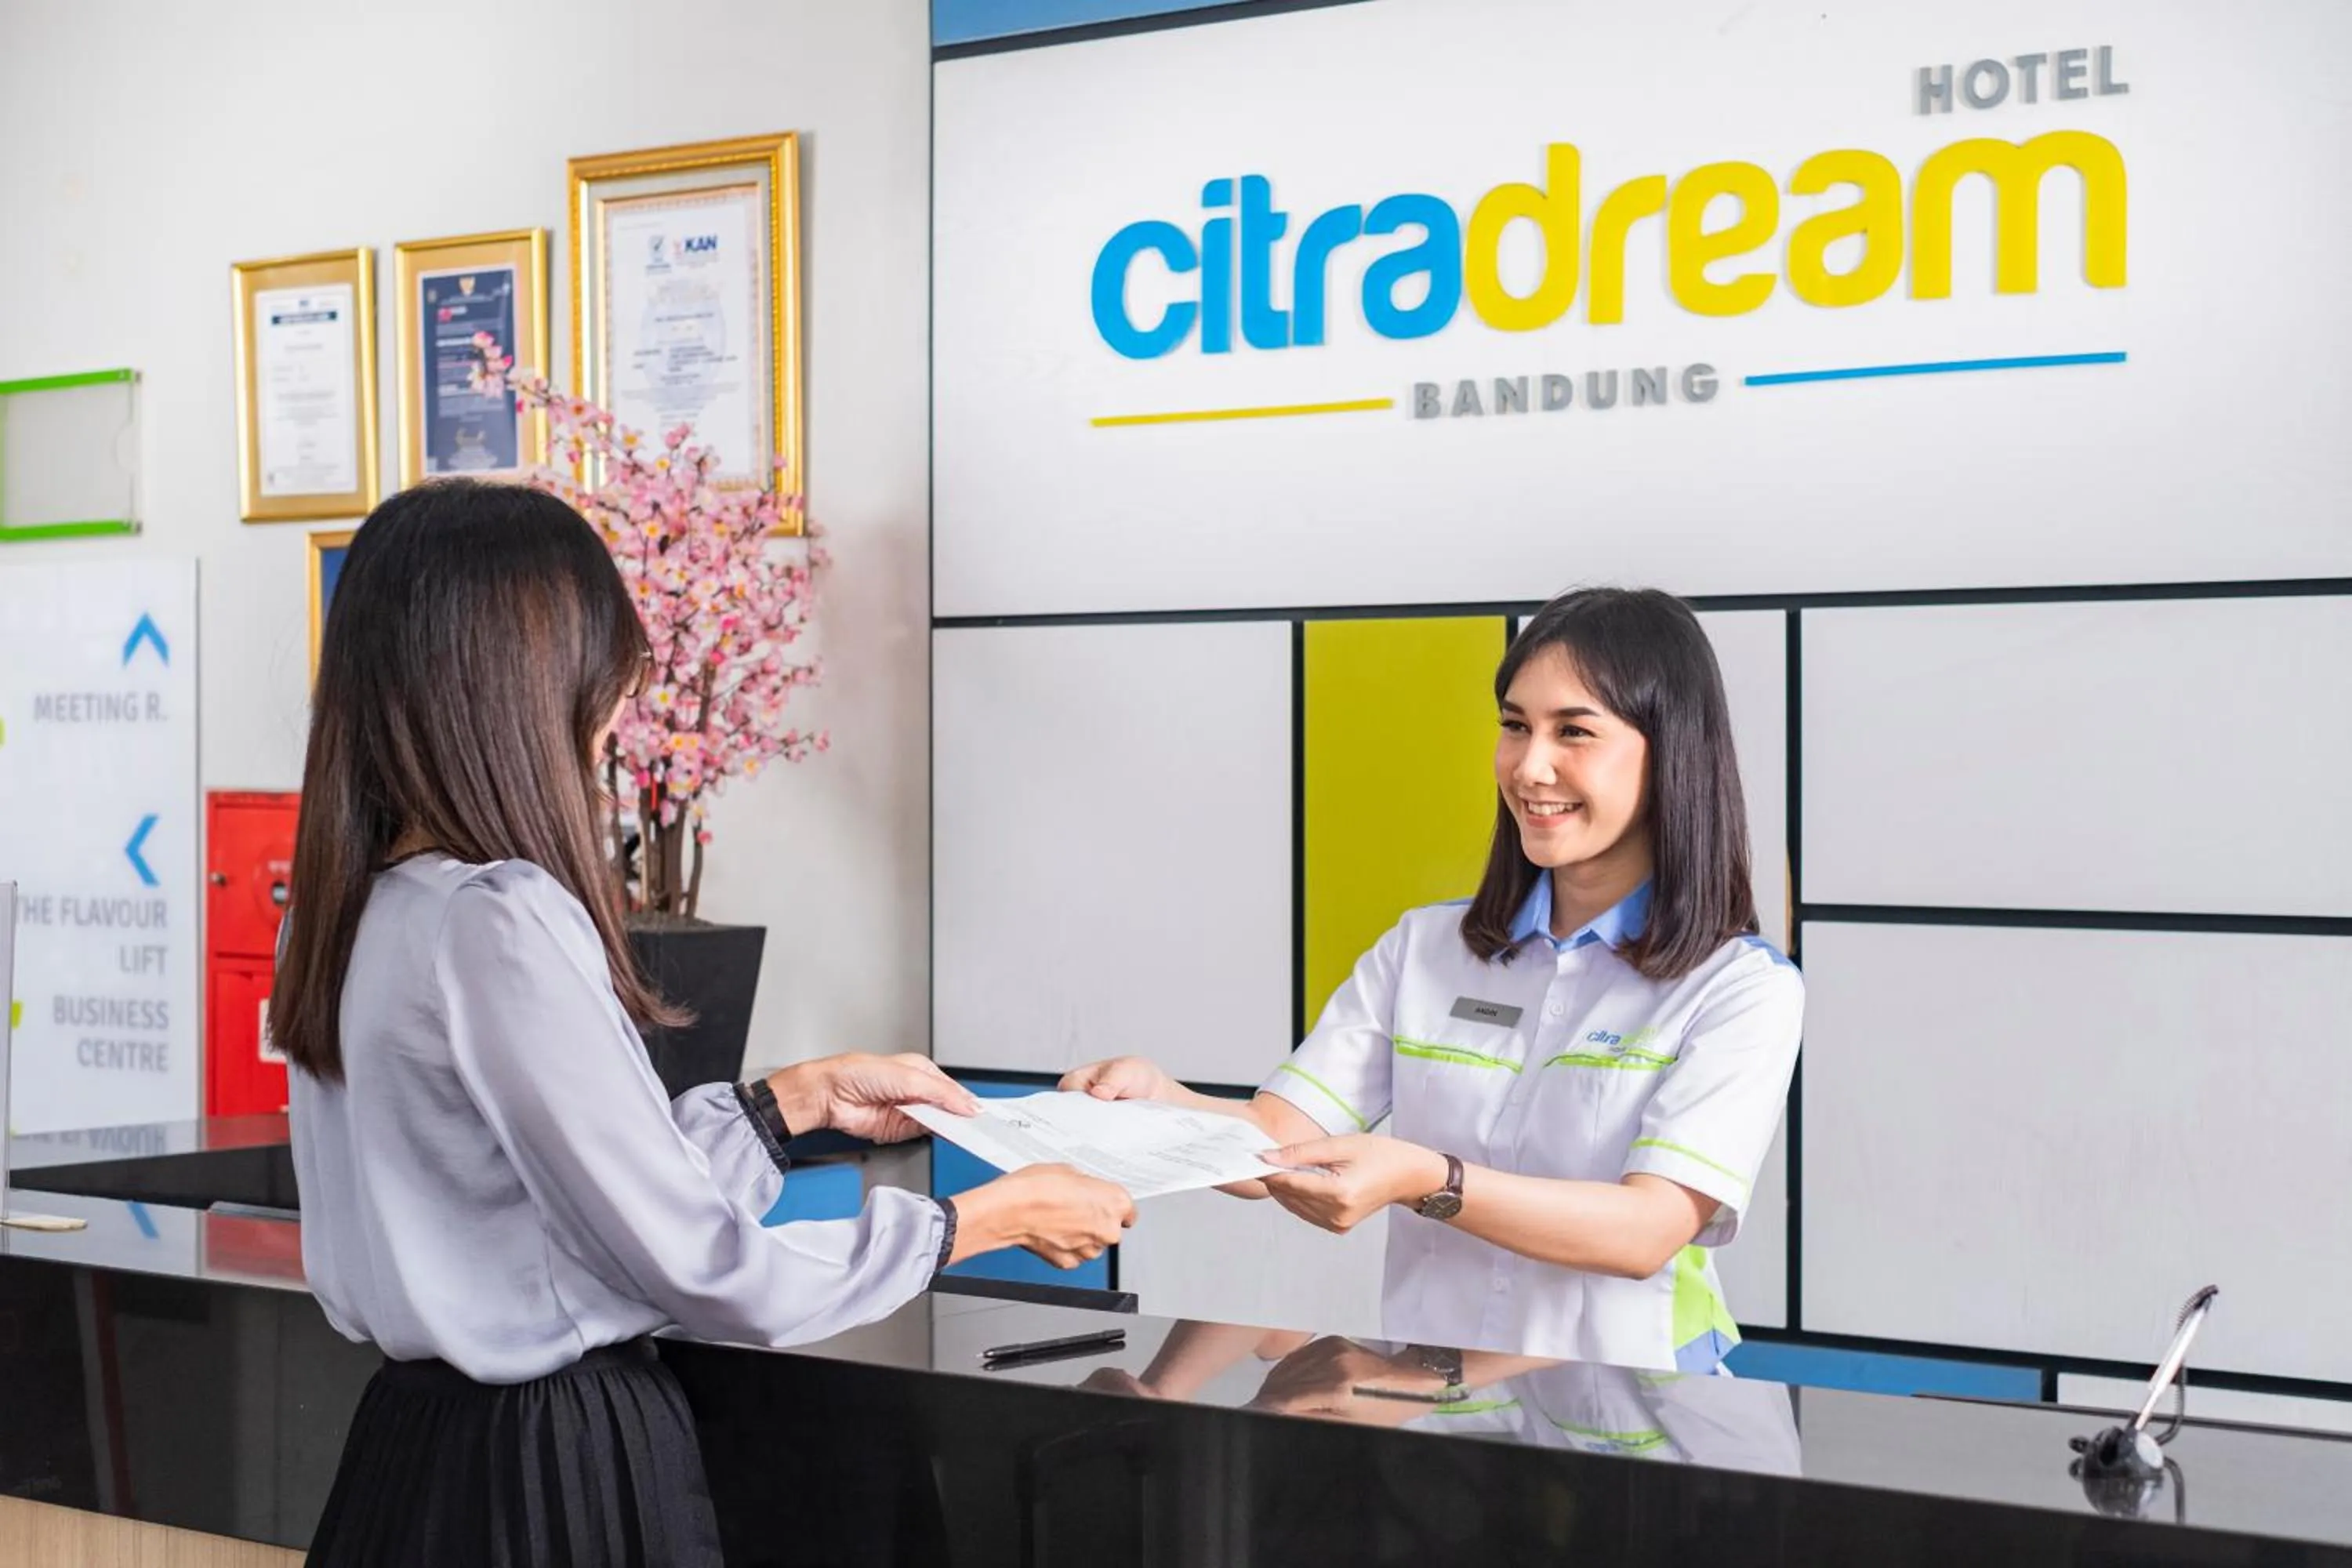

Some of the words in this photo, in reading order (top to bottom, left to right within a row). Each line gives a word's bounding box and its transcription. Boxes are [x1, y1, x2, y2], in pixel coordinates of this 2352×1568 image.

[1912, 44, 2129, 115] HOTEL
[684, 234, 717, 252] KAN
[1091, 129, 2128, 360] citradream
[1408, 361, 1720, 420] BANDUNG
[34, 691, 137, 723] MEETING
[146, 690, 168, 722] R.
[60, 897, 168, 928] FLAVOUR
[119, 945, 168, 974] LIFT
[53, 994, 169, 1030] BUSINESS
[76, 1037, 169, 1073] CENTRE
